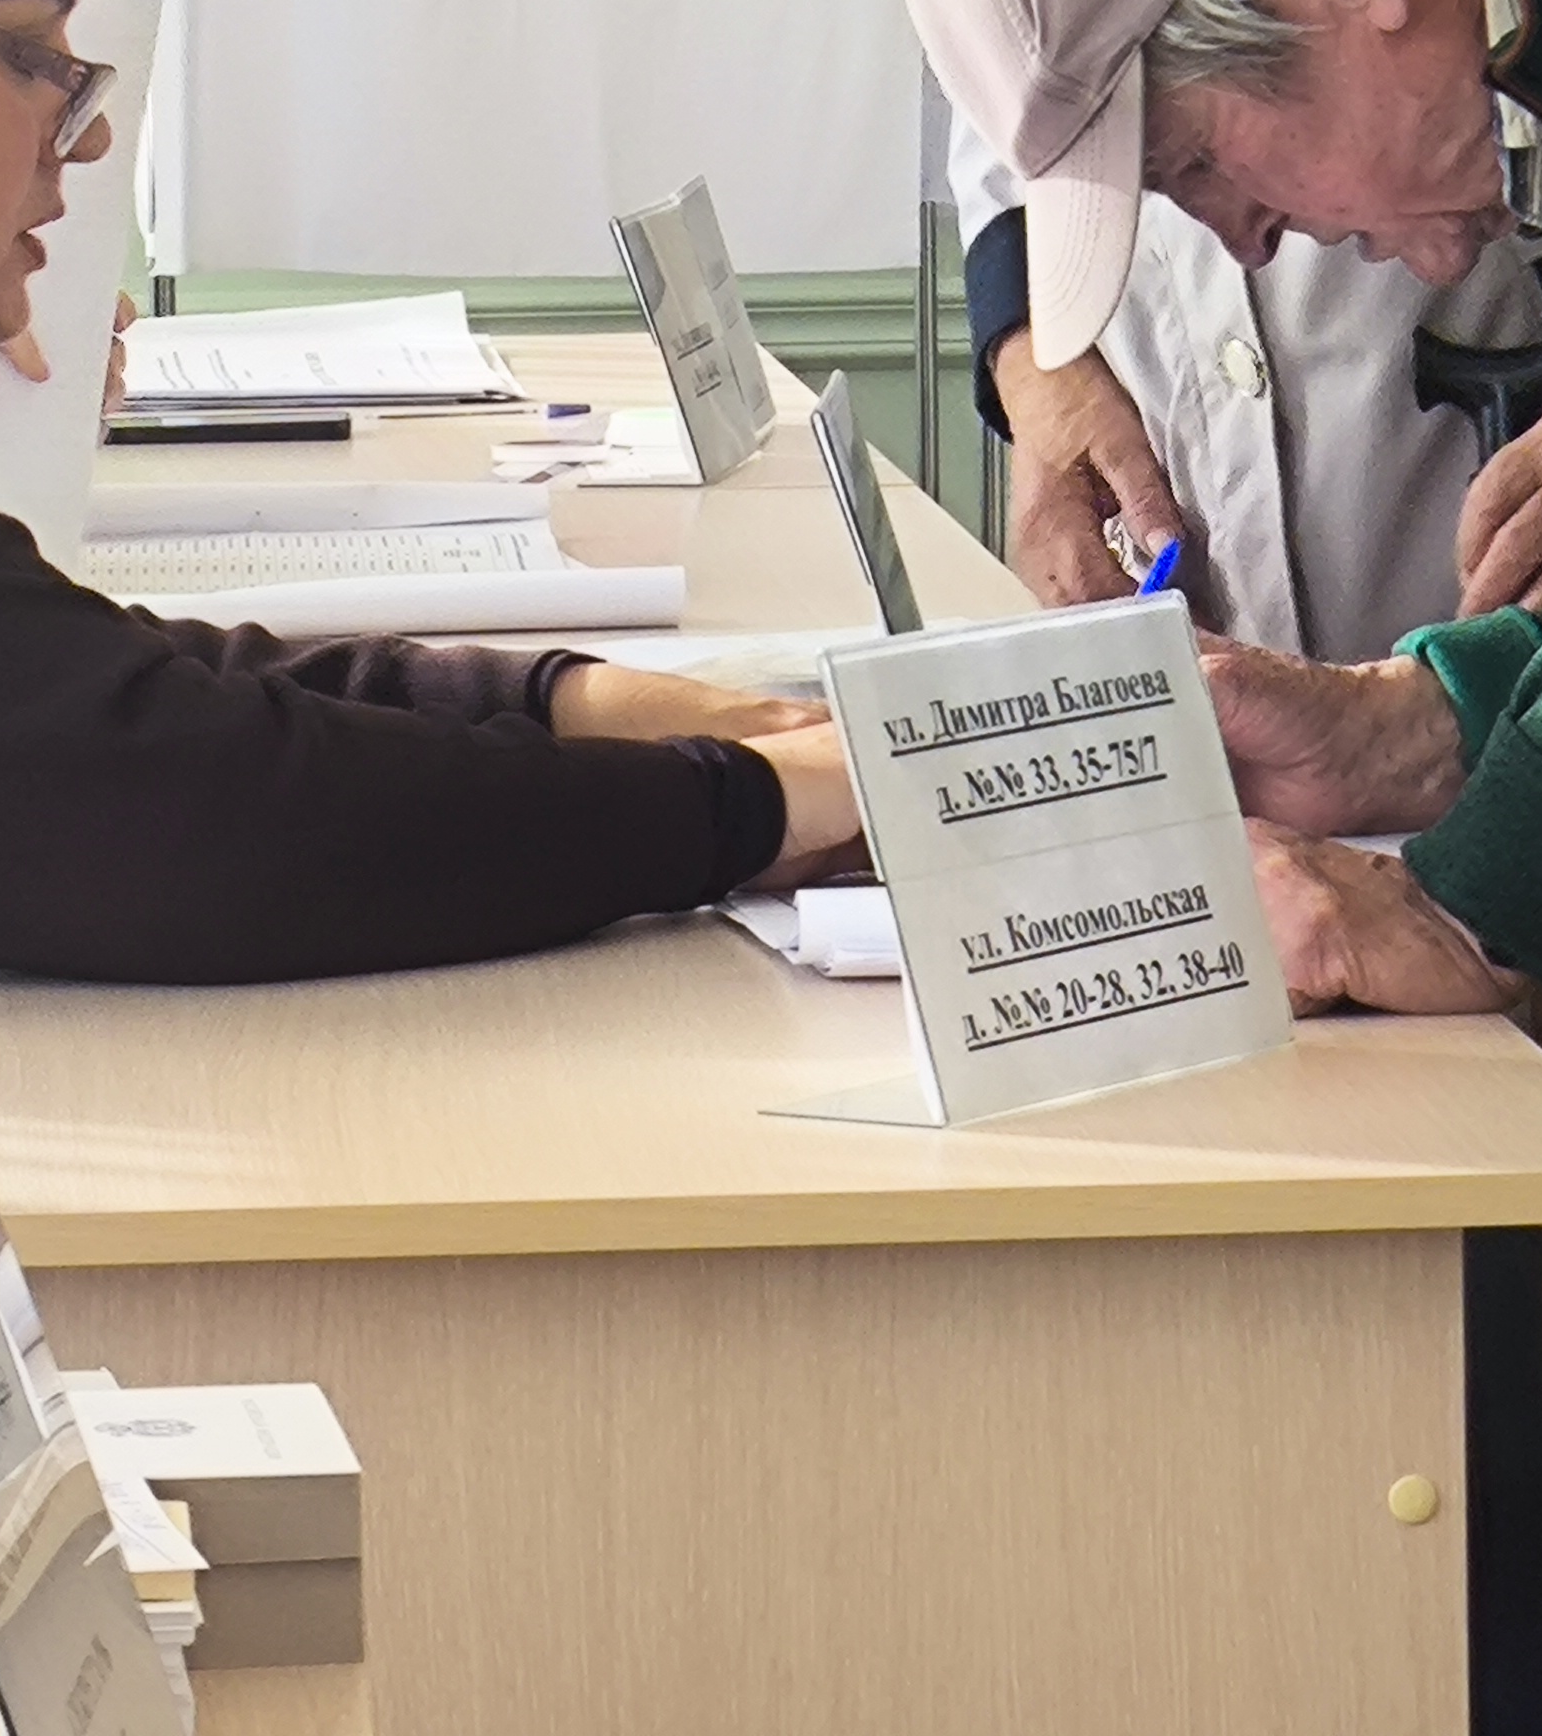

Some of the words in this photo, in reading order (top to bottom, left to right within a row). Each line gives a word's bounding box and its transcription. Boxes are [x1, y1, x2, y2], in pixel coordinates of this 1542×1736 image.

[883, 716, 925, 747] ул.
[929, 691, 1051, 743] Димитра
[1050, 669, 1172, 715] Благоева
[936, 786, 962, 817] д.
[1028, 754, 1071, 795] 33,
[1071, 735, 1159, 786] 35-75/7
[961, 932, 1002, 965] ул.
[1004, 884, 1210, 953] Комсомольская
[962, 1013, 987, 1045] д.
[1056, 969, 1136, 1018] 20-28,
[1136, 960, 1178, 1000] 32,
[1178, 941, 1246, 991] 38-40
